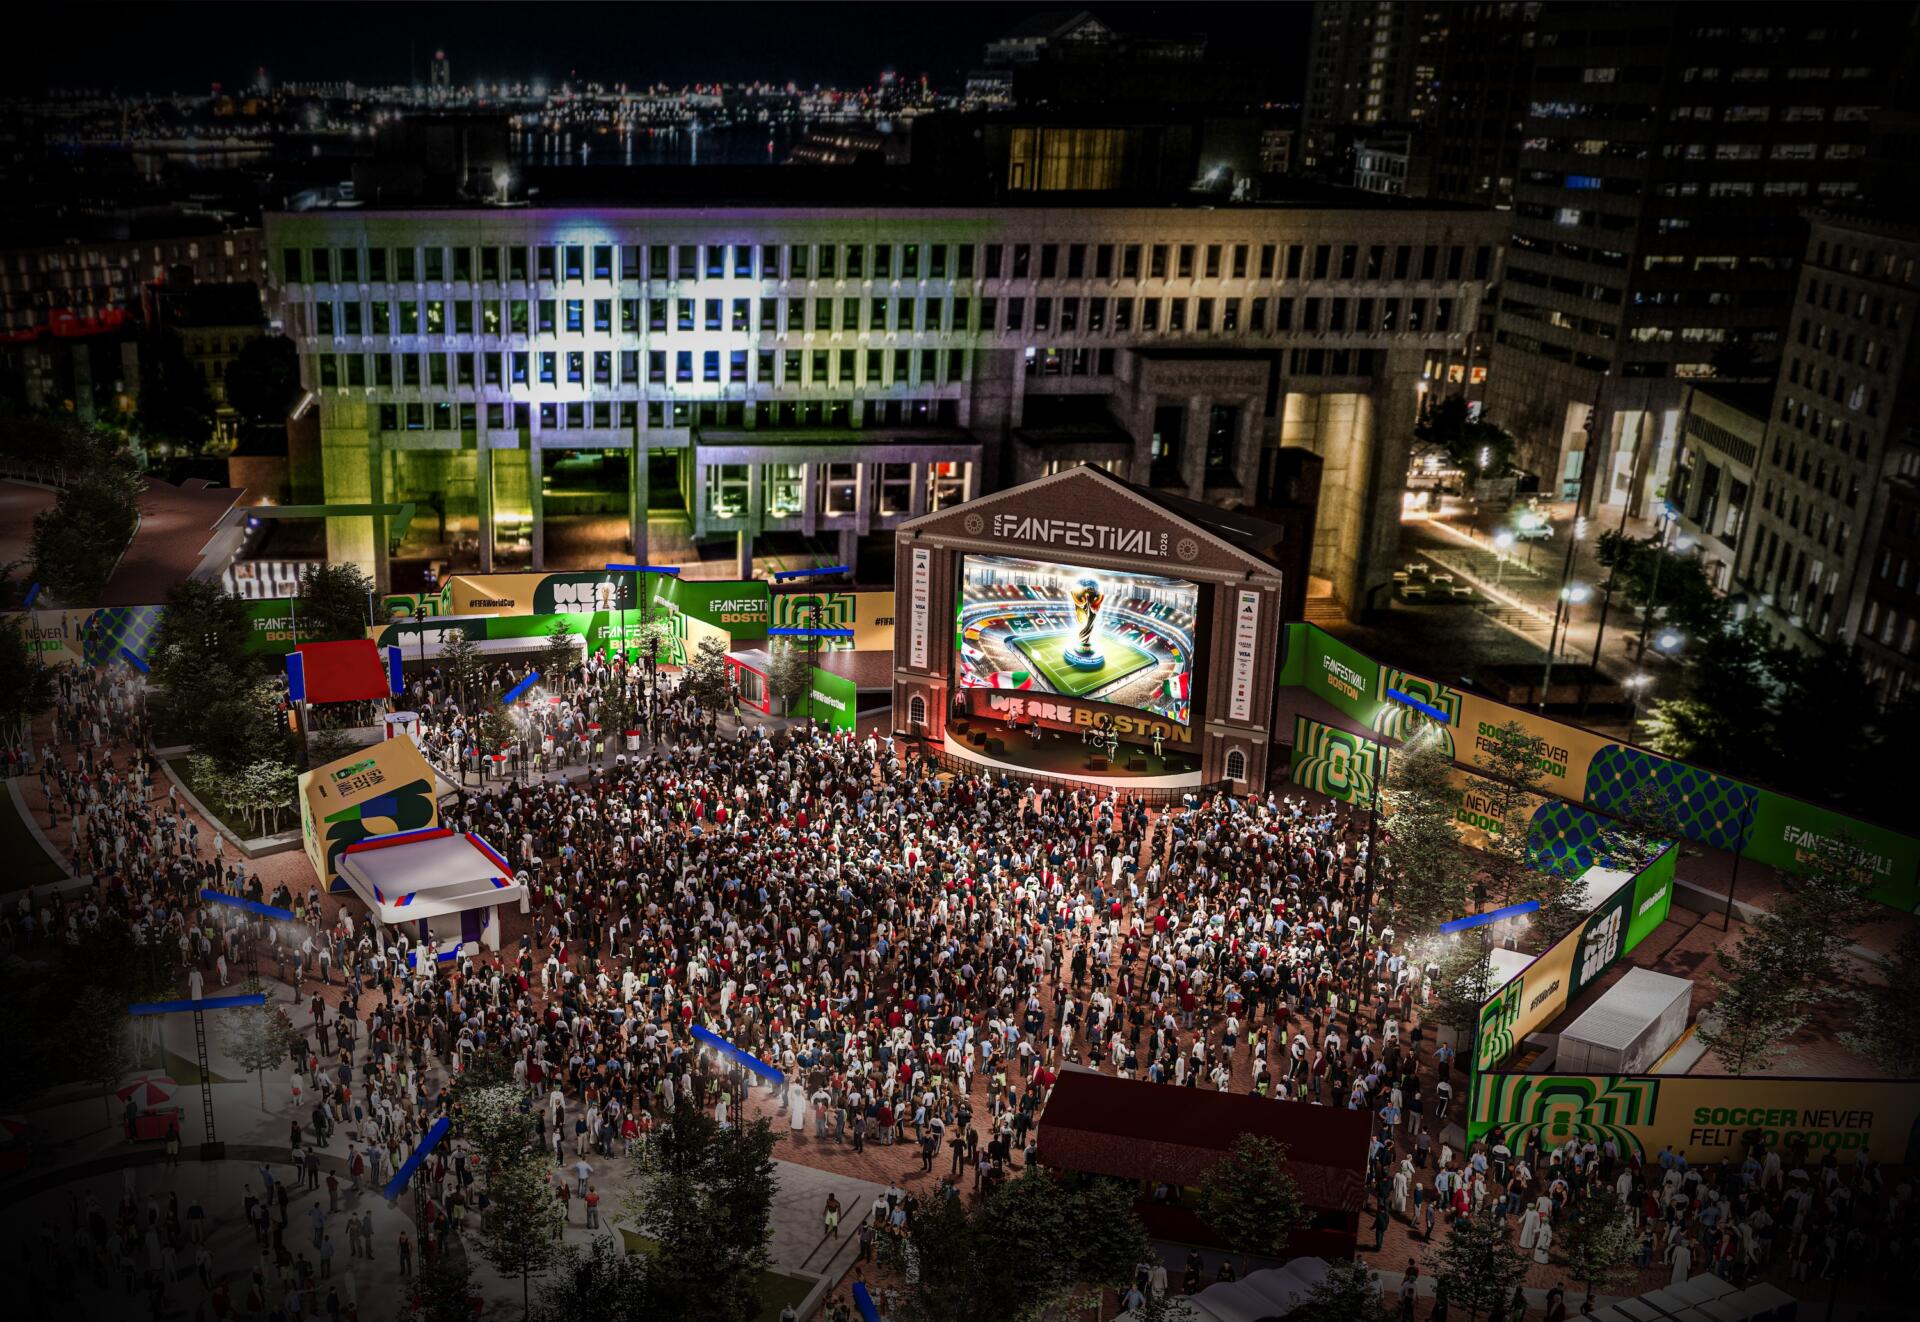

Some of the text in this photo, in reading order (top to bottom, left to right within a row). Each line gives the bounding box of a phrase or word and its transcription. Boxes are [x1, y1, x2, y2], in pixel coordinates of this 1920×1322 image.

[994, 514, 1002, 537] FIFA
[1159, 533, 1169, 557] 2026
[553, 582, 595, 604] WE
[1327, 673, 1359, 701] BOSTON
[989, 693, 1194, 744] WE ARE BOSTON
[1693, 1106, 1875, 1129] SOCCER NEVER
[1688, 1129, 1738, 1147] FELT
